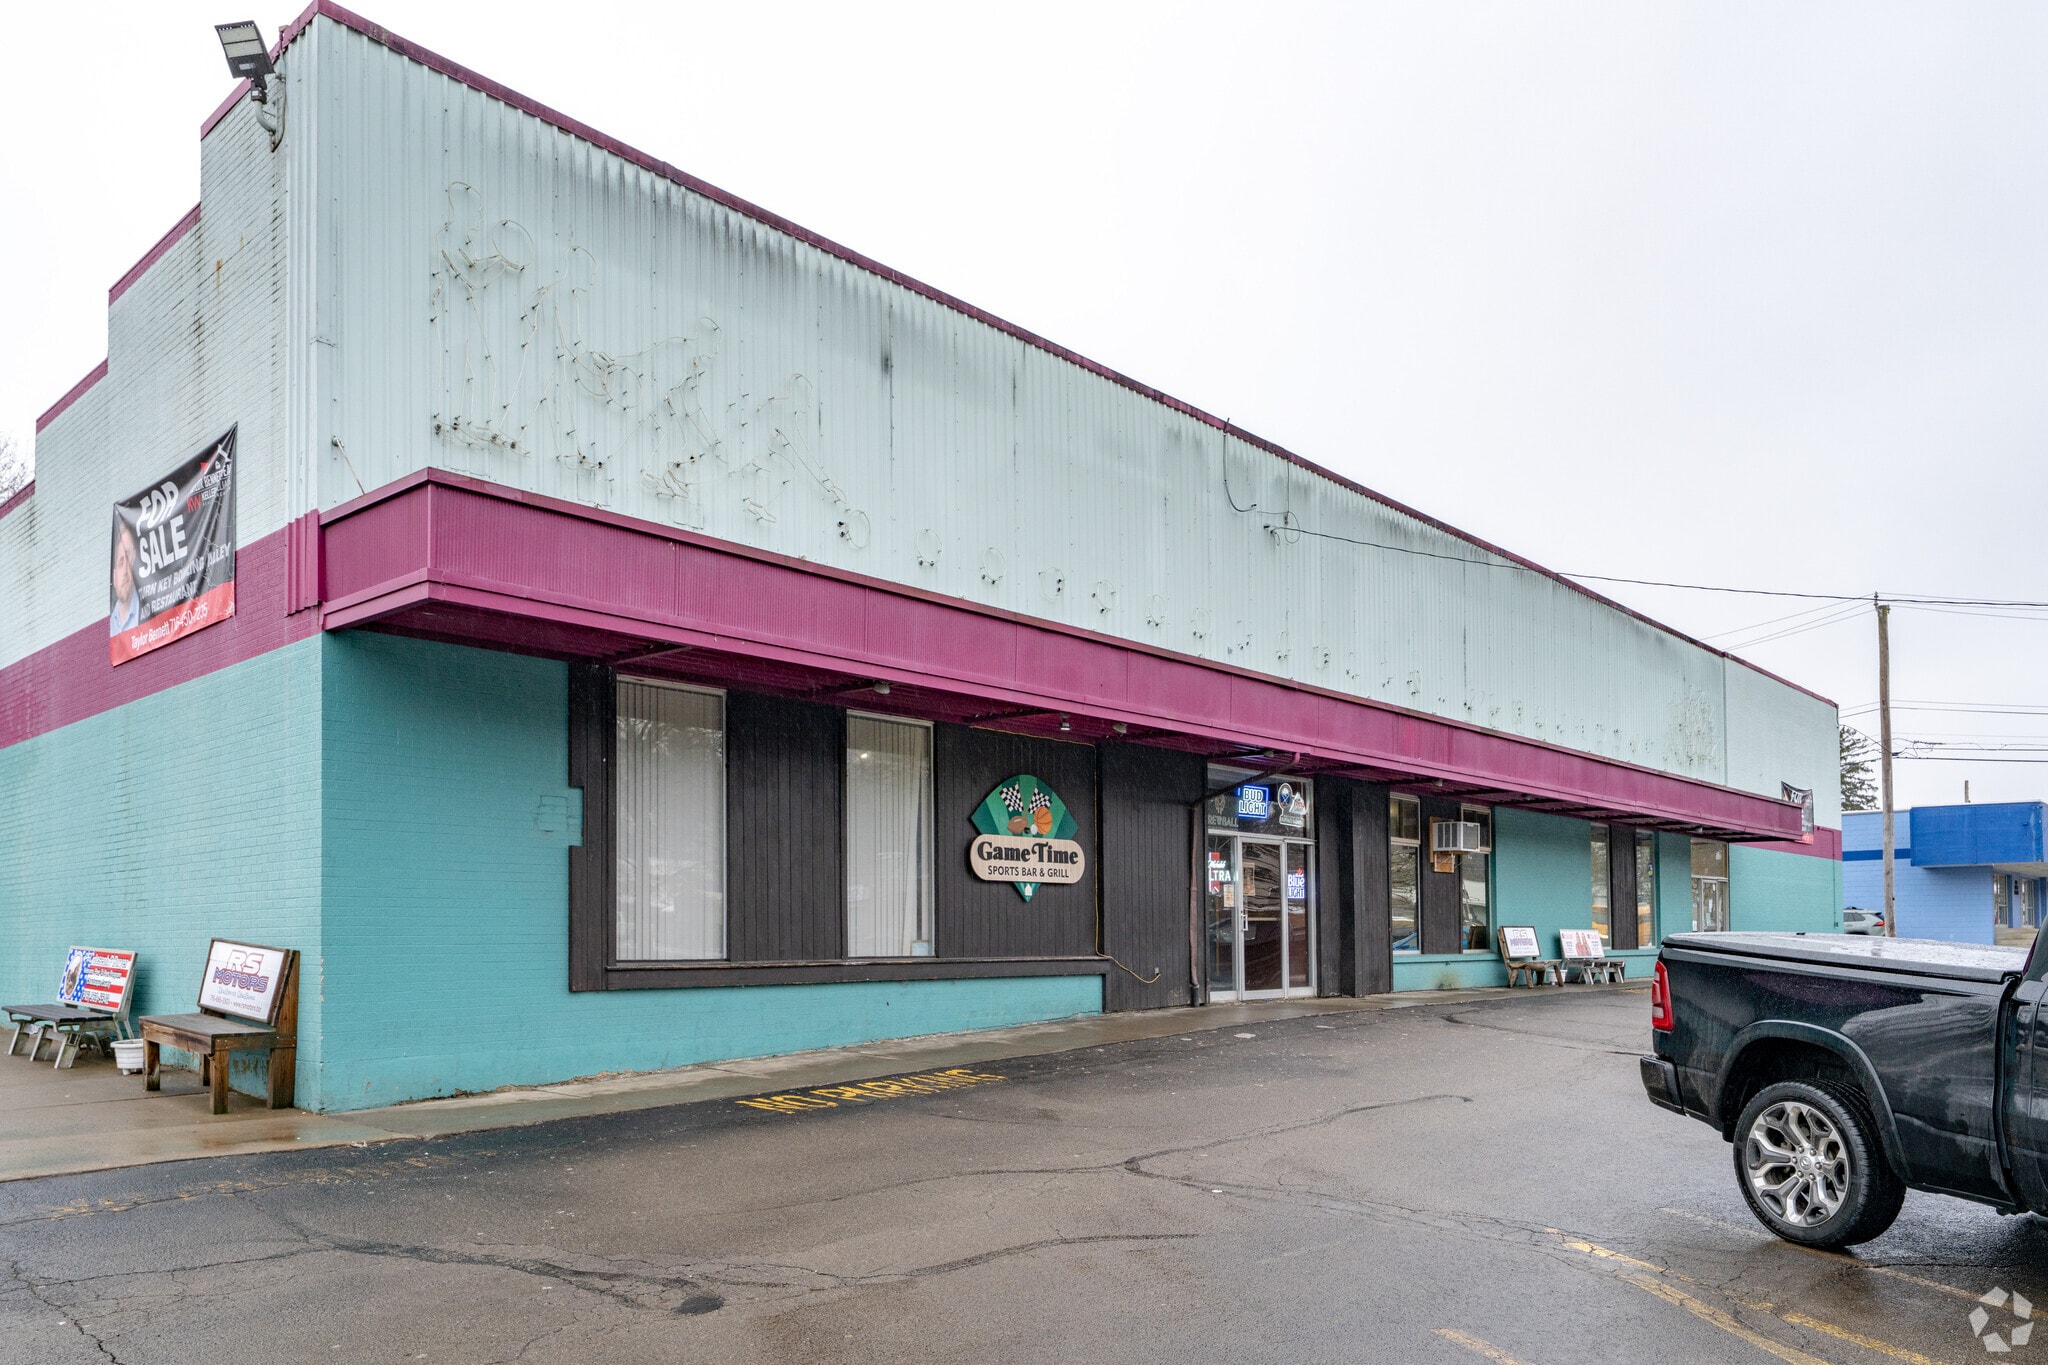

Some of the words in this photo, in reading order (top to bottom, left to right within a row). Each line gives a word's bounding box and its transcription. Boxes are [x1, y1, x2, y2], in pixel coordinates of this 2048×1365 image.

[136, 481, 179, 537] FOR
[139, 514, 188, 578] SALE
[157, 575, 173, 592] KEY
[207, 542, 231, 567] ALLEY
[151, 580, 198, 613] RESTAURANT
[131, 632, 149, 651] Taylor
[148, 622, 170, 642] Bennett
[1239, 800, 1265, 815] LIGHT
[1243, 788, 1263, 801] BUD
[977, 841, 1031, 862] Game
[1031, 841, 1078, 865] Time
[988, 865, 1019, 876] SPORTS
[1021, 867, 1037, 877] BAR
[1040, 867, 1045, 877] &
[1047, 868, 1069, 878] GRILL
[225, 949, 265, 975] RS
[212, 966, 270, 993] MOTORS
